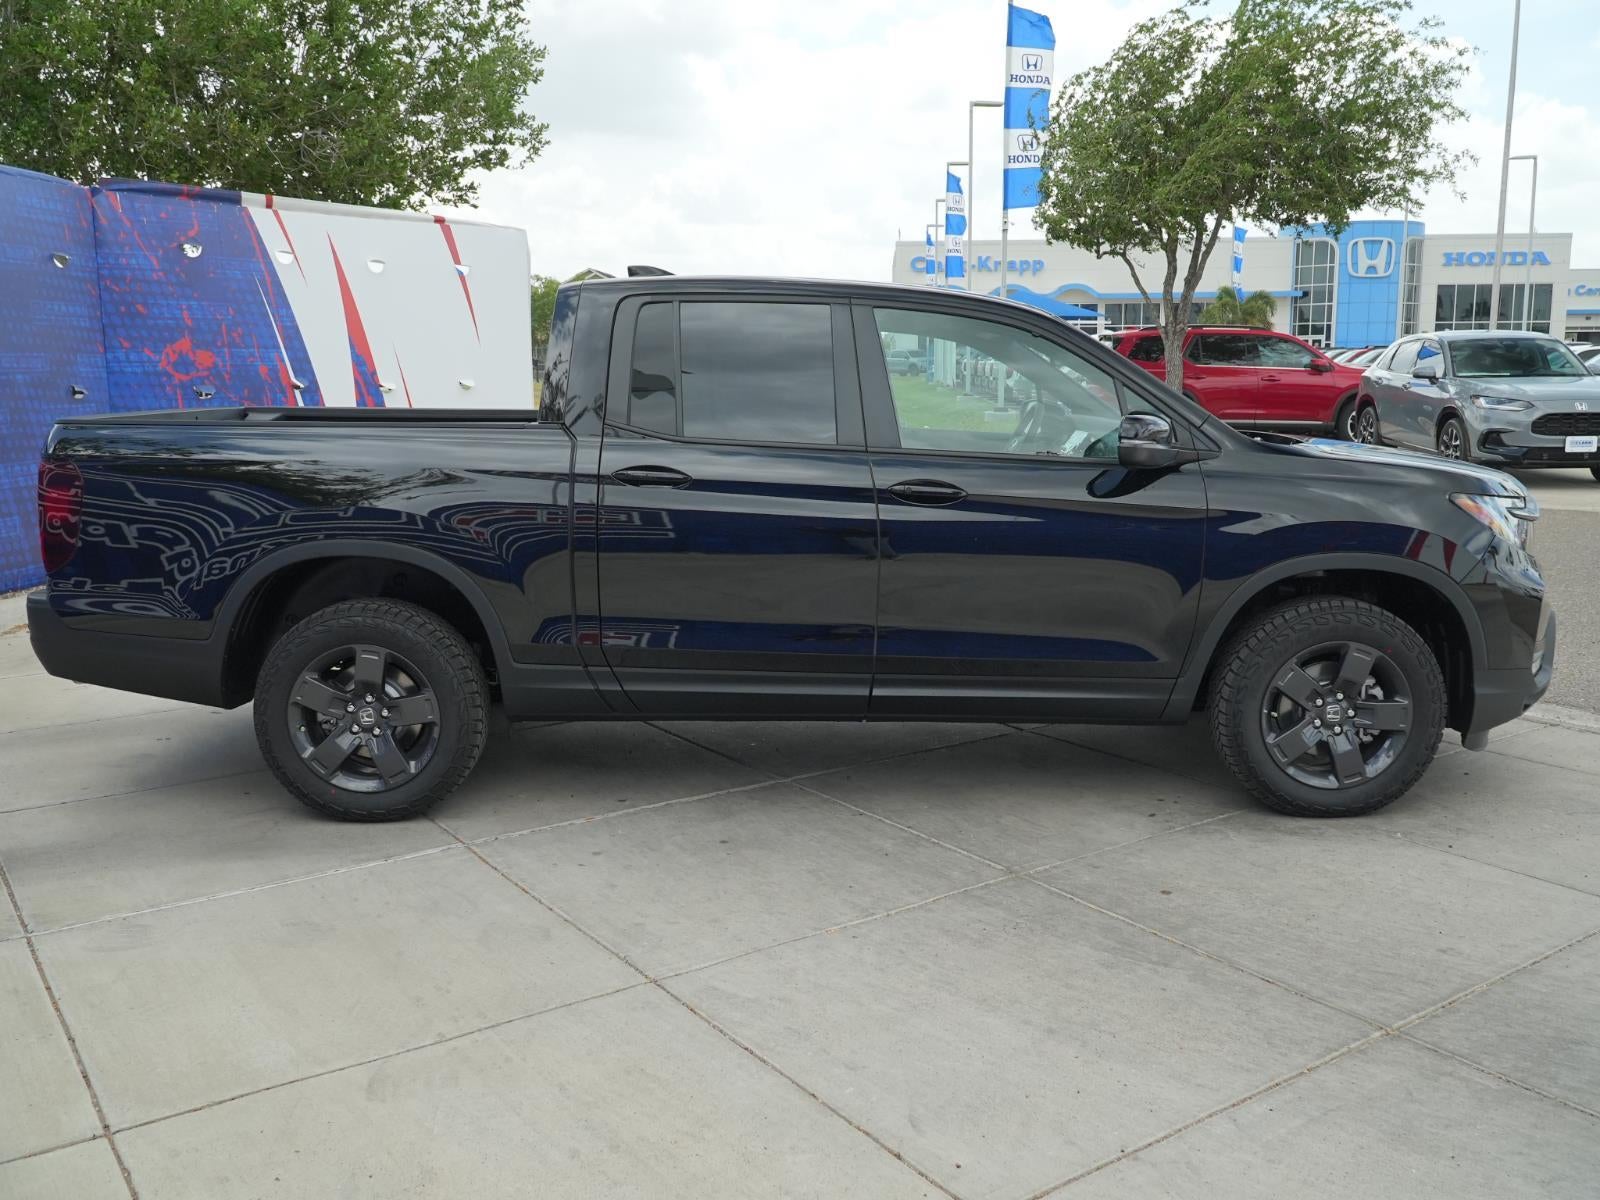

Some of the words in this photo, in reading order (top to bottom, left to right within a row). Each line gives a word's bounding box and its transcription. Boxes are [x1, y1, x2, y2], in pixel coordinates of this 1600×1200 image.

[1009, 74, 1051, 85] HONDA
[1008, 154, 1041, 164] HOND
[1442, 251, 1552, 266] HONDA
